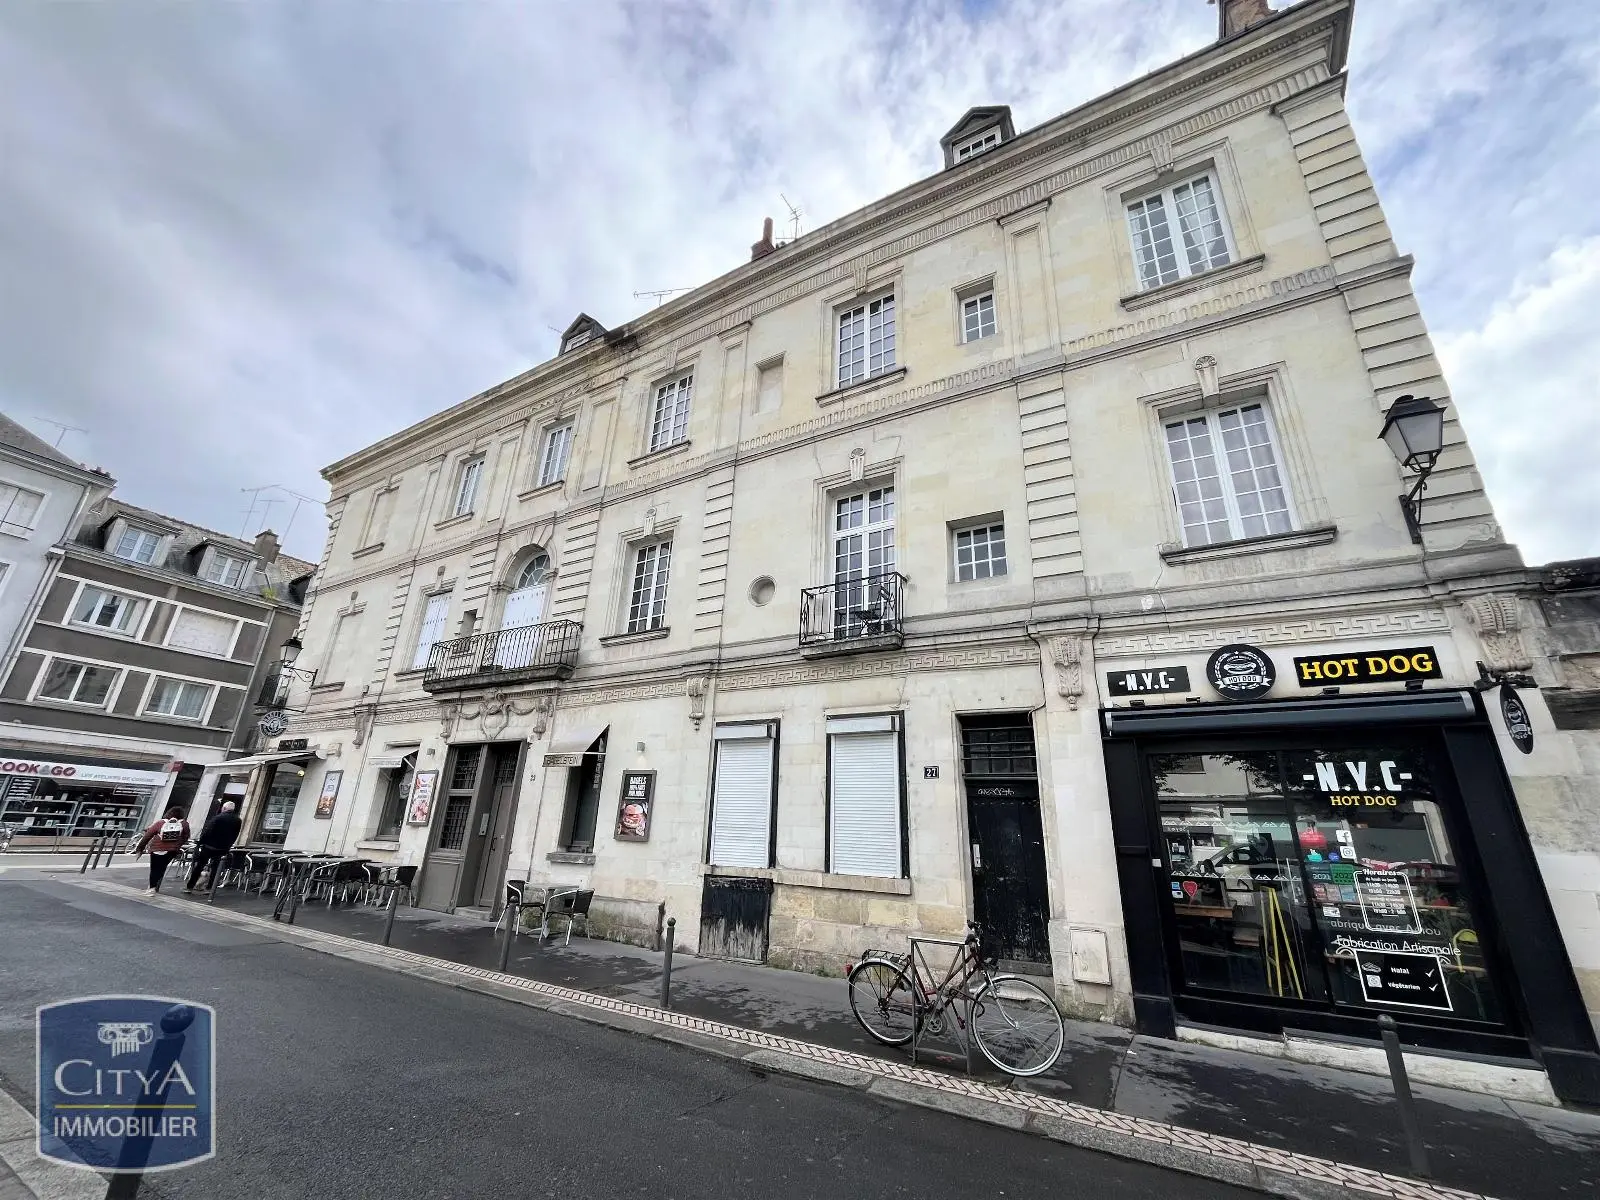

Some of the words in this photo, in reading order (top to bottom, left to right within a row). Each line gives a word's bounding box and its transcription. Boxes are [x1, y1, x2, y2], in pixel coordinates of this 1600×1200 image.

[1300, 658, 1358, 680] HOT
[1365, 653, 1433, 675] DOG
[926, 768, 936, 777] 27
[1330, 795, 1360, 806] HOT
[1363, 795, 1397, 806] DOG
[1362, 868, 1397, 876] Horaires
[1336, 934, 1398, 951] Fabrication
[1402, 939, 1462, 956] Artisanale
